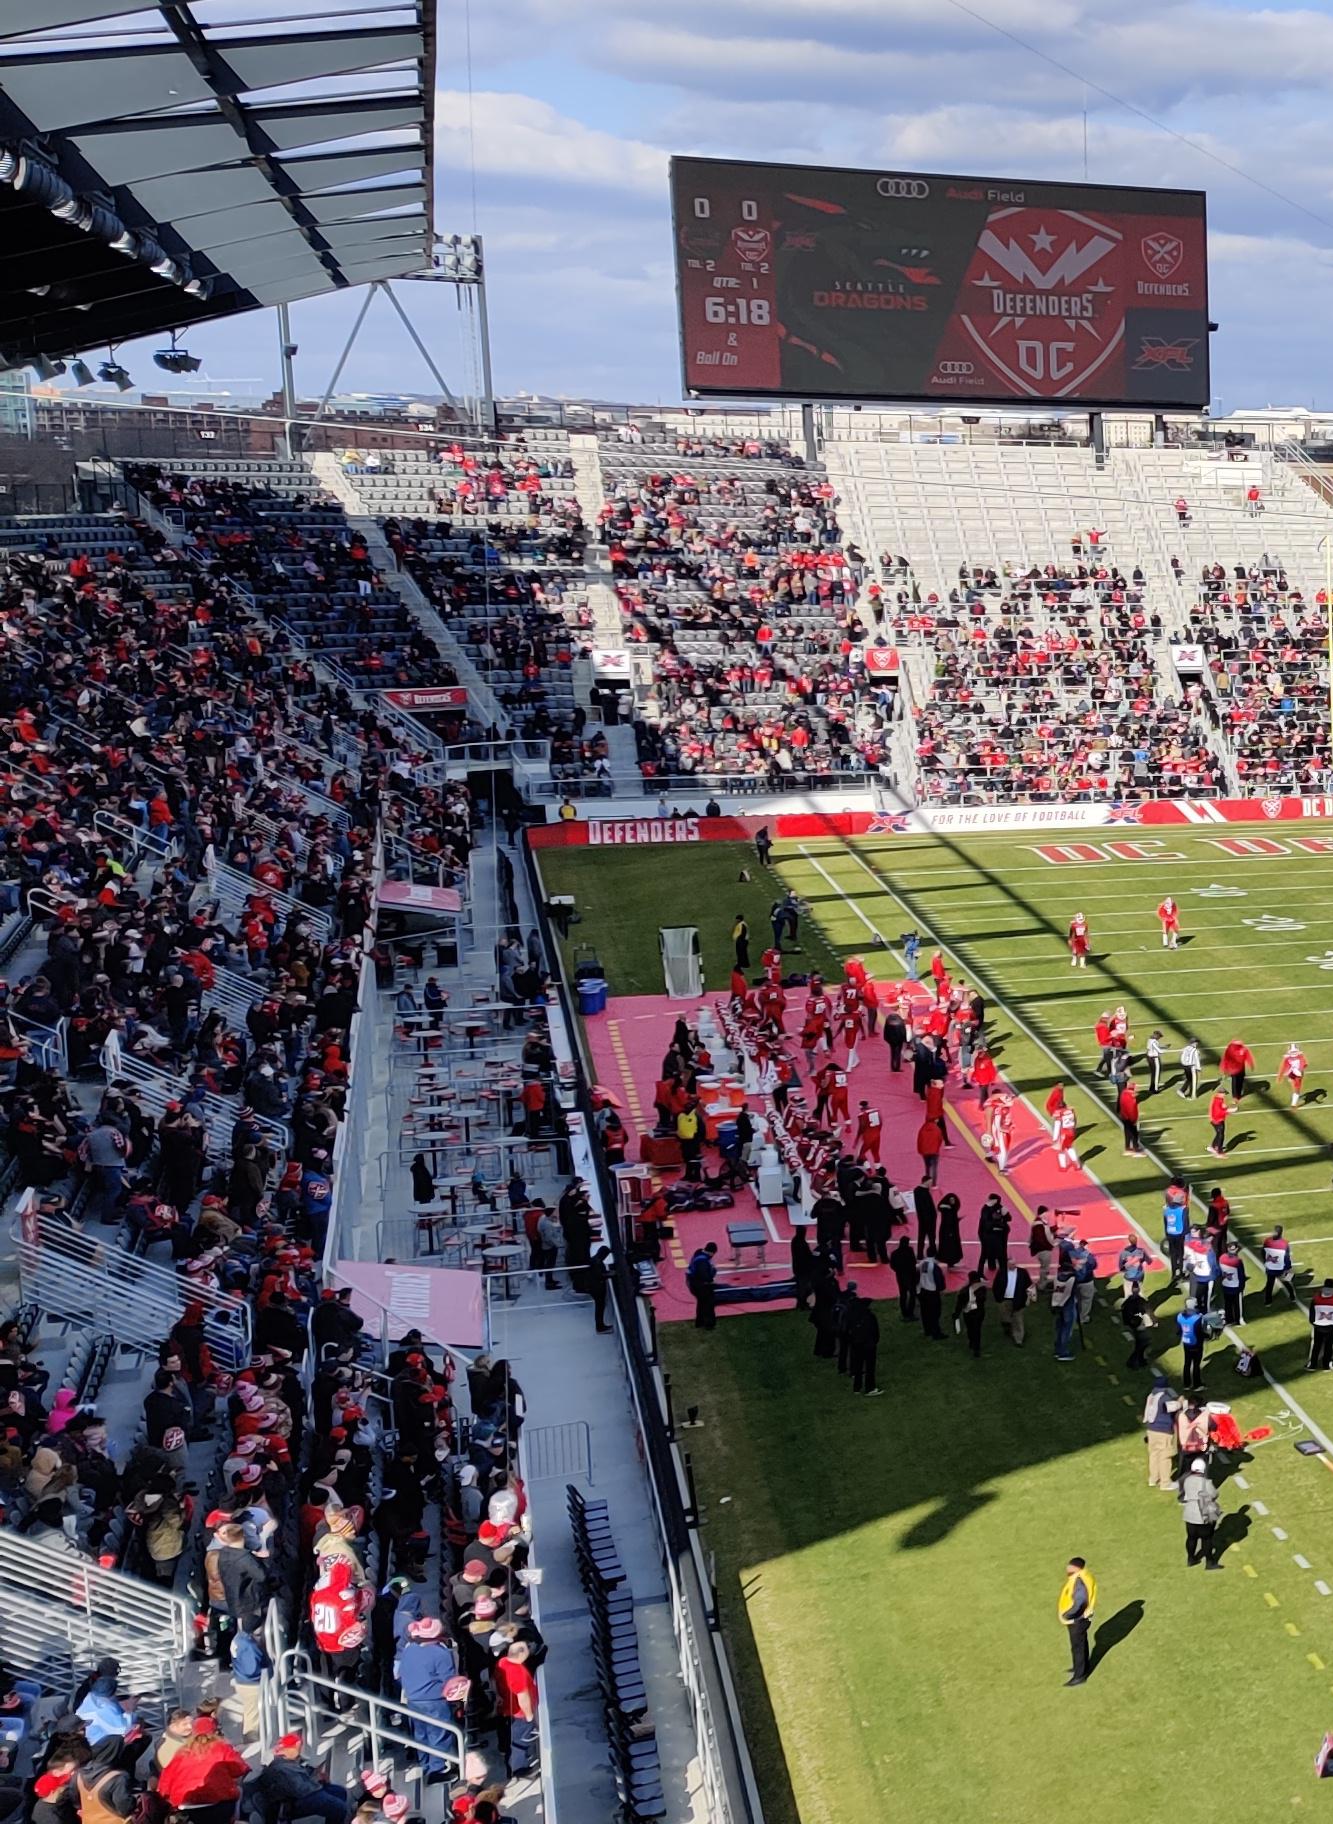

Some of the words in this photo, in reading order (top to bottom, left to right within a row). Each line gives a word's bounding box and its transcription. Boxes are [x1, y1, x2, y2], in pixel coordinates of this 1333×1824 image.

[945, 186, 983, 200] Audi
[987, 189, 1025, 203] Field
[694, 198, 710, 218] 0
[742, 200, 758, 221] 0
[705, 259, 716, 272] 2
[759, 262, 769, 274] 2
[751, 277, 759, 289] 1
[834, 279, 906, 294] SEATTLE
[1136, 280, 1189, 297] DEFENDERS
[813, 290, 929, 311] DRAGONS
[992, 288, 1094, 318] DEFENDERS
[704, 296, 771, 326] 6:18
[727, 332, 738, 347] &
[695, 351, 720, 365] Ball
[722, 352, 739, 366] On
[1016, 339, 1076, 381] DC
[931, 376, 957, 385] Audi
[958, 376, 985, 386] Field
[1102, 802, 1145, 825] XFL
[1302, 799, 1321, 817] DC
[866, 809, 914, 834] XFL
[931, 814, 955, 826] FOR
[958, 813, 978, 824] THE
[983, 812, 1011, 824] LOVE
[1014, 811, 1028, 823] OF
[1031, 809, 1087, 822] FOOTBALL
[588, 818, 700, 846] DEFENDERS
[1016, 840, 1188, 866] DC
